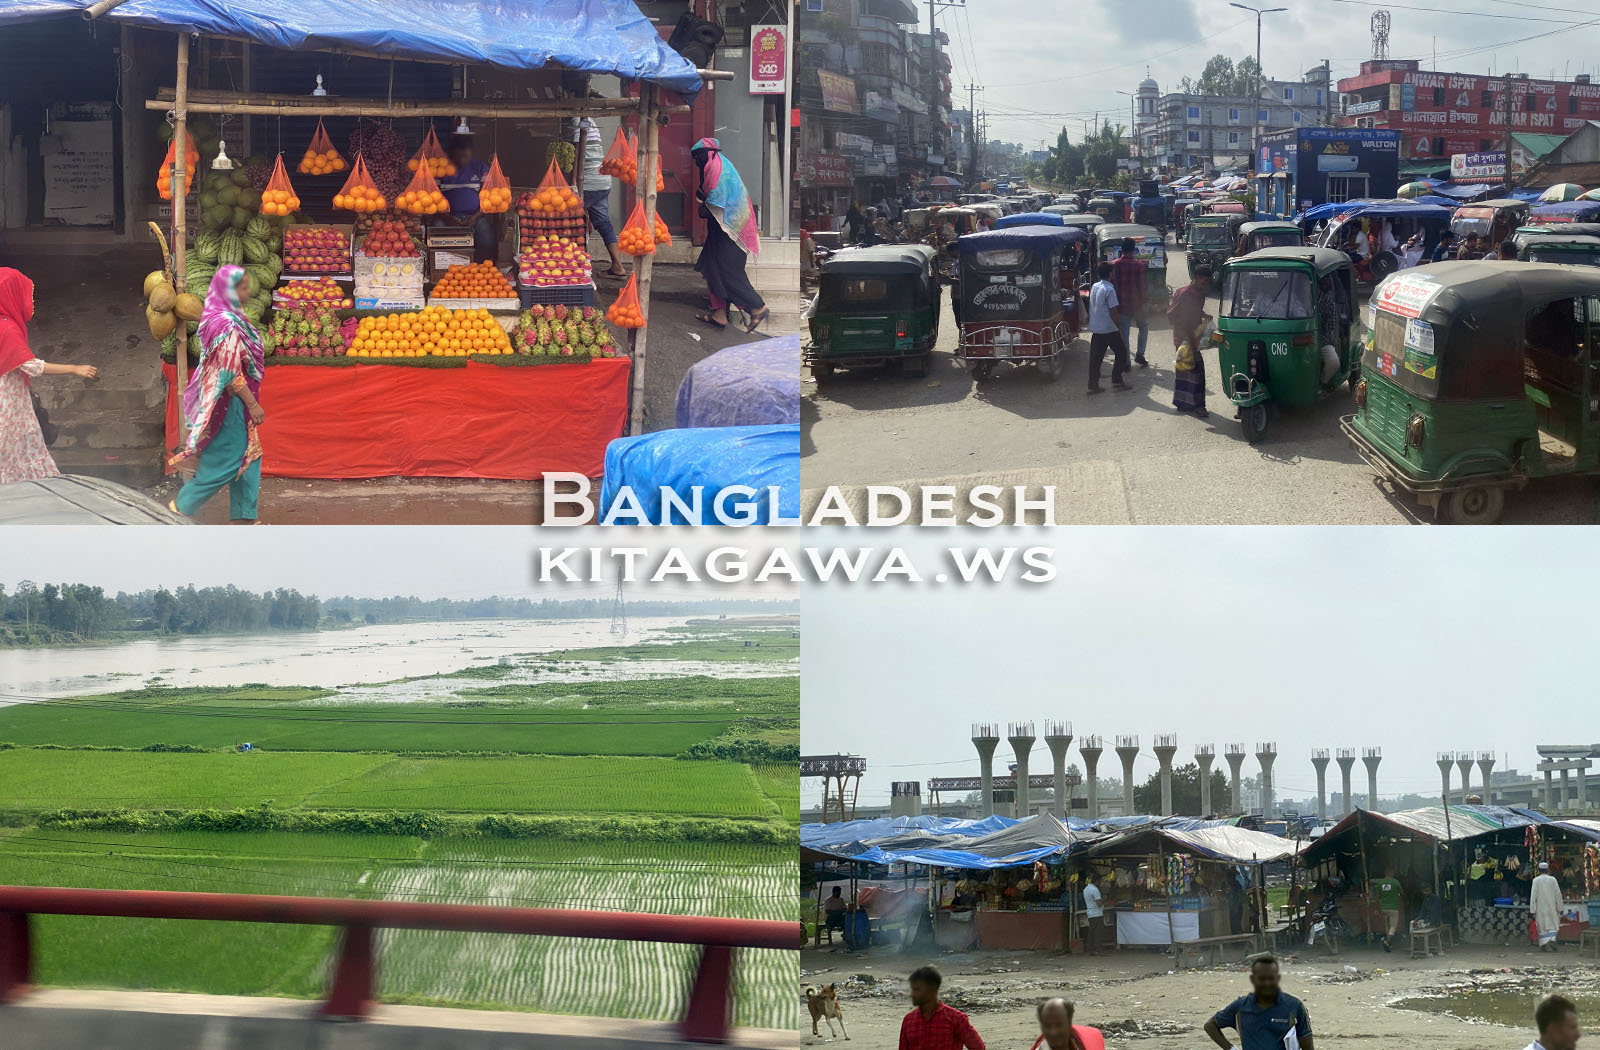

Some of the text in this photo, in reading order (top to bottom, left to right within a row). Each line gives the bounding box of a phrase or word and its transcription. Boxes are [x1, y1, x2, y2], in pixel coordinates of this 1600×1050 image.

[1403, 72, 1477, 90] ANWAR ISPAT
[1402, 111, 1447, 125] আনোয়ার
[1530, 112, 1555, 127] ISPAT
[1361, 140, 1397, 148] WALTON
[1271, 342, 1288, 356] CNG
